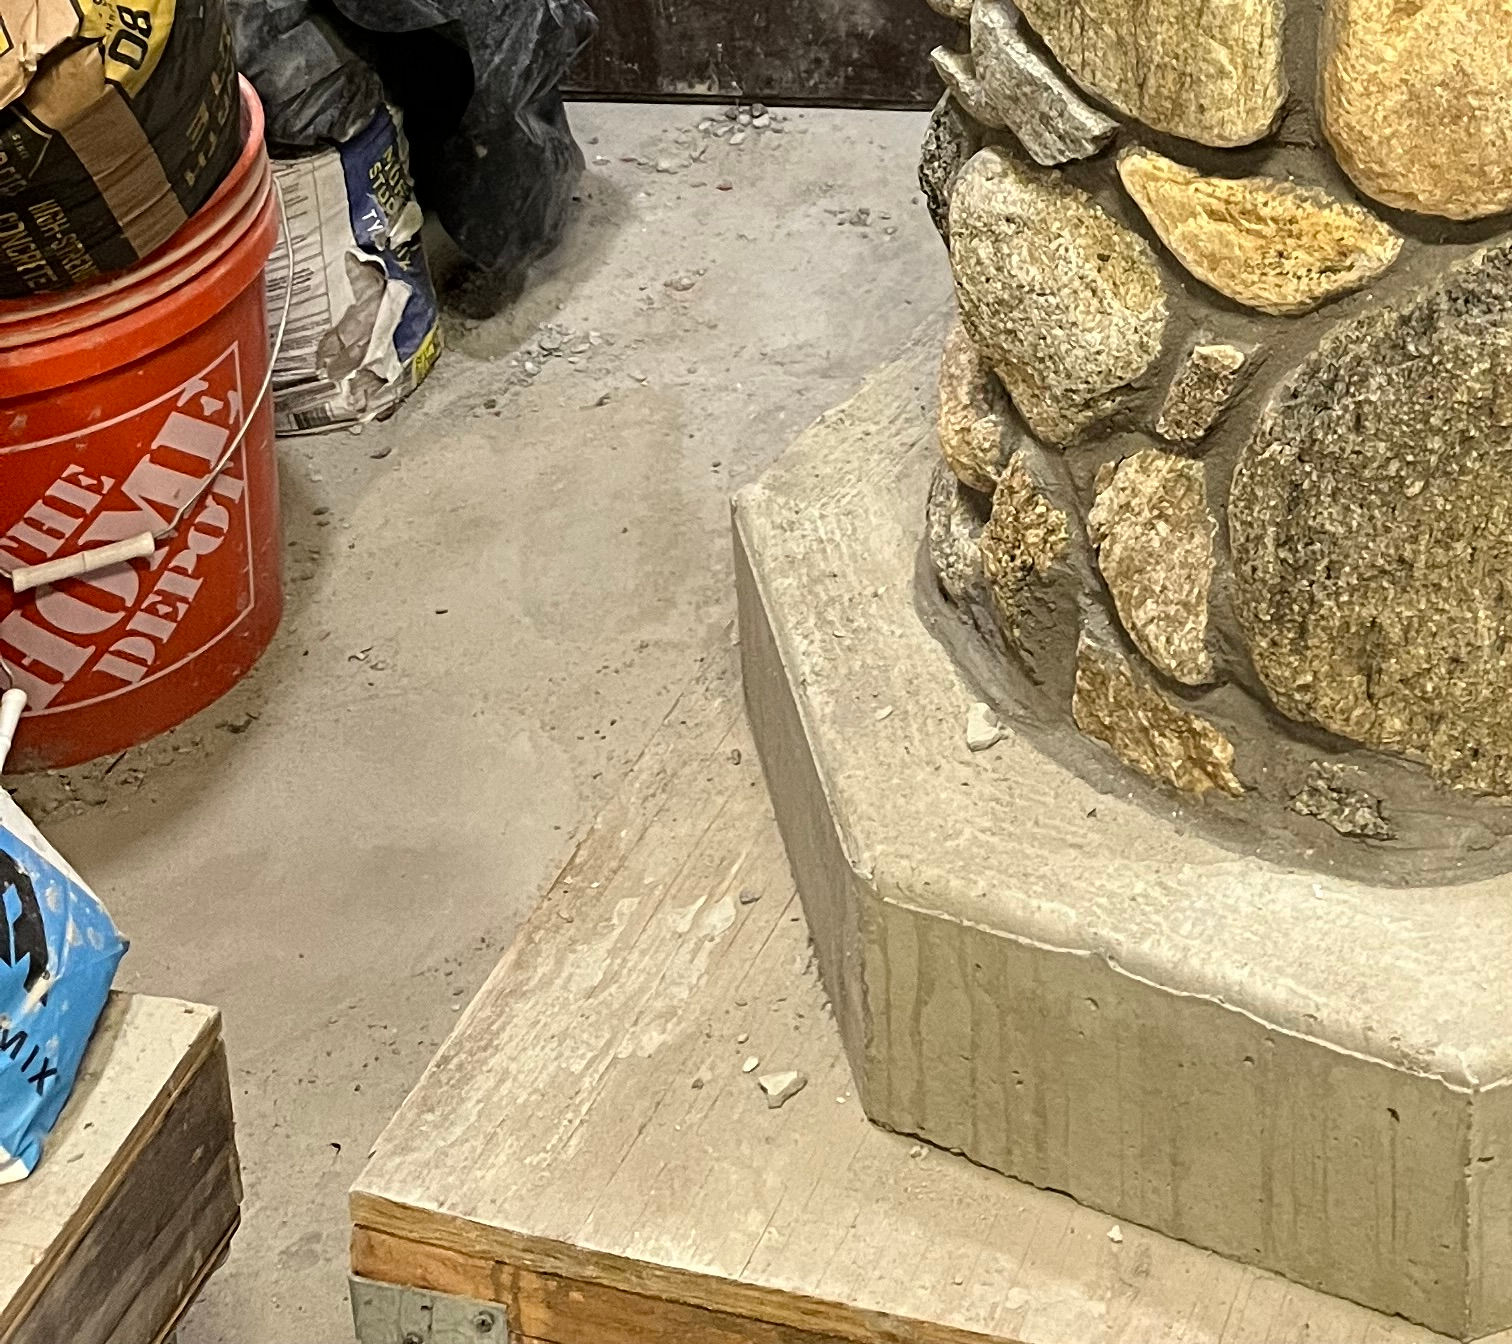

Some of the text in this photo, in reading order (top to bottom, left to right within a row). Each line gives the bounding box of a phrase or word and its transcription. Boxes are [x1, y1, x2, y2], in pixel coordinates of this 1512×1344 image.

[108, 4, 152, 70] 80
[92, 461, 245, 683] DEPOT
[0, 1028, 58, 1097] MIX
